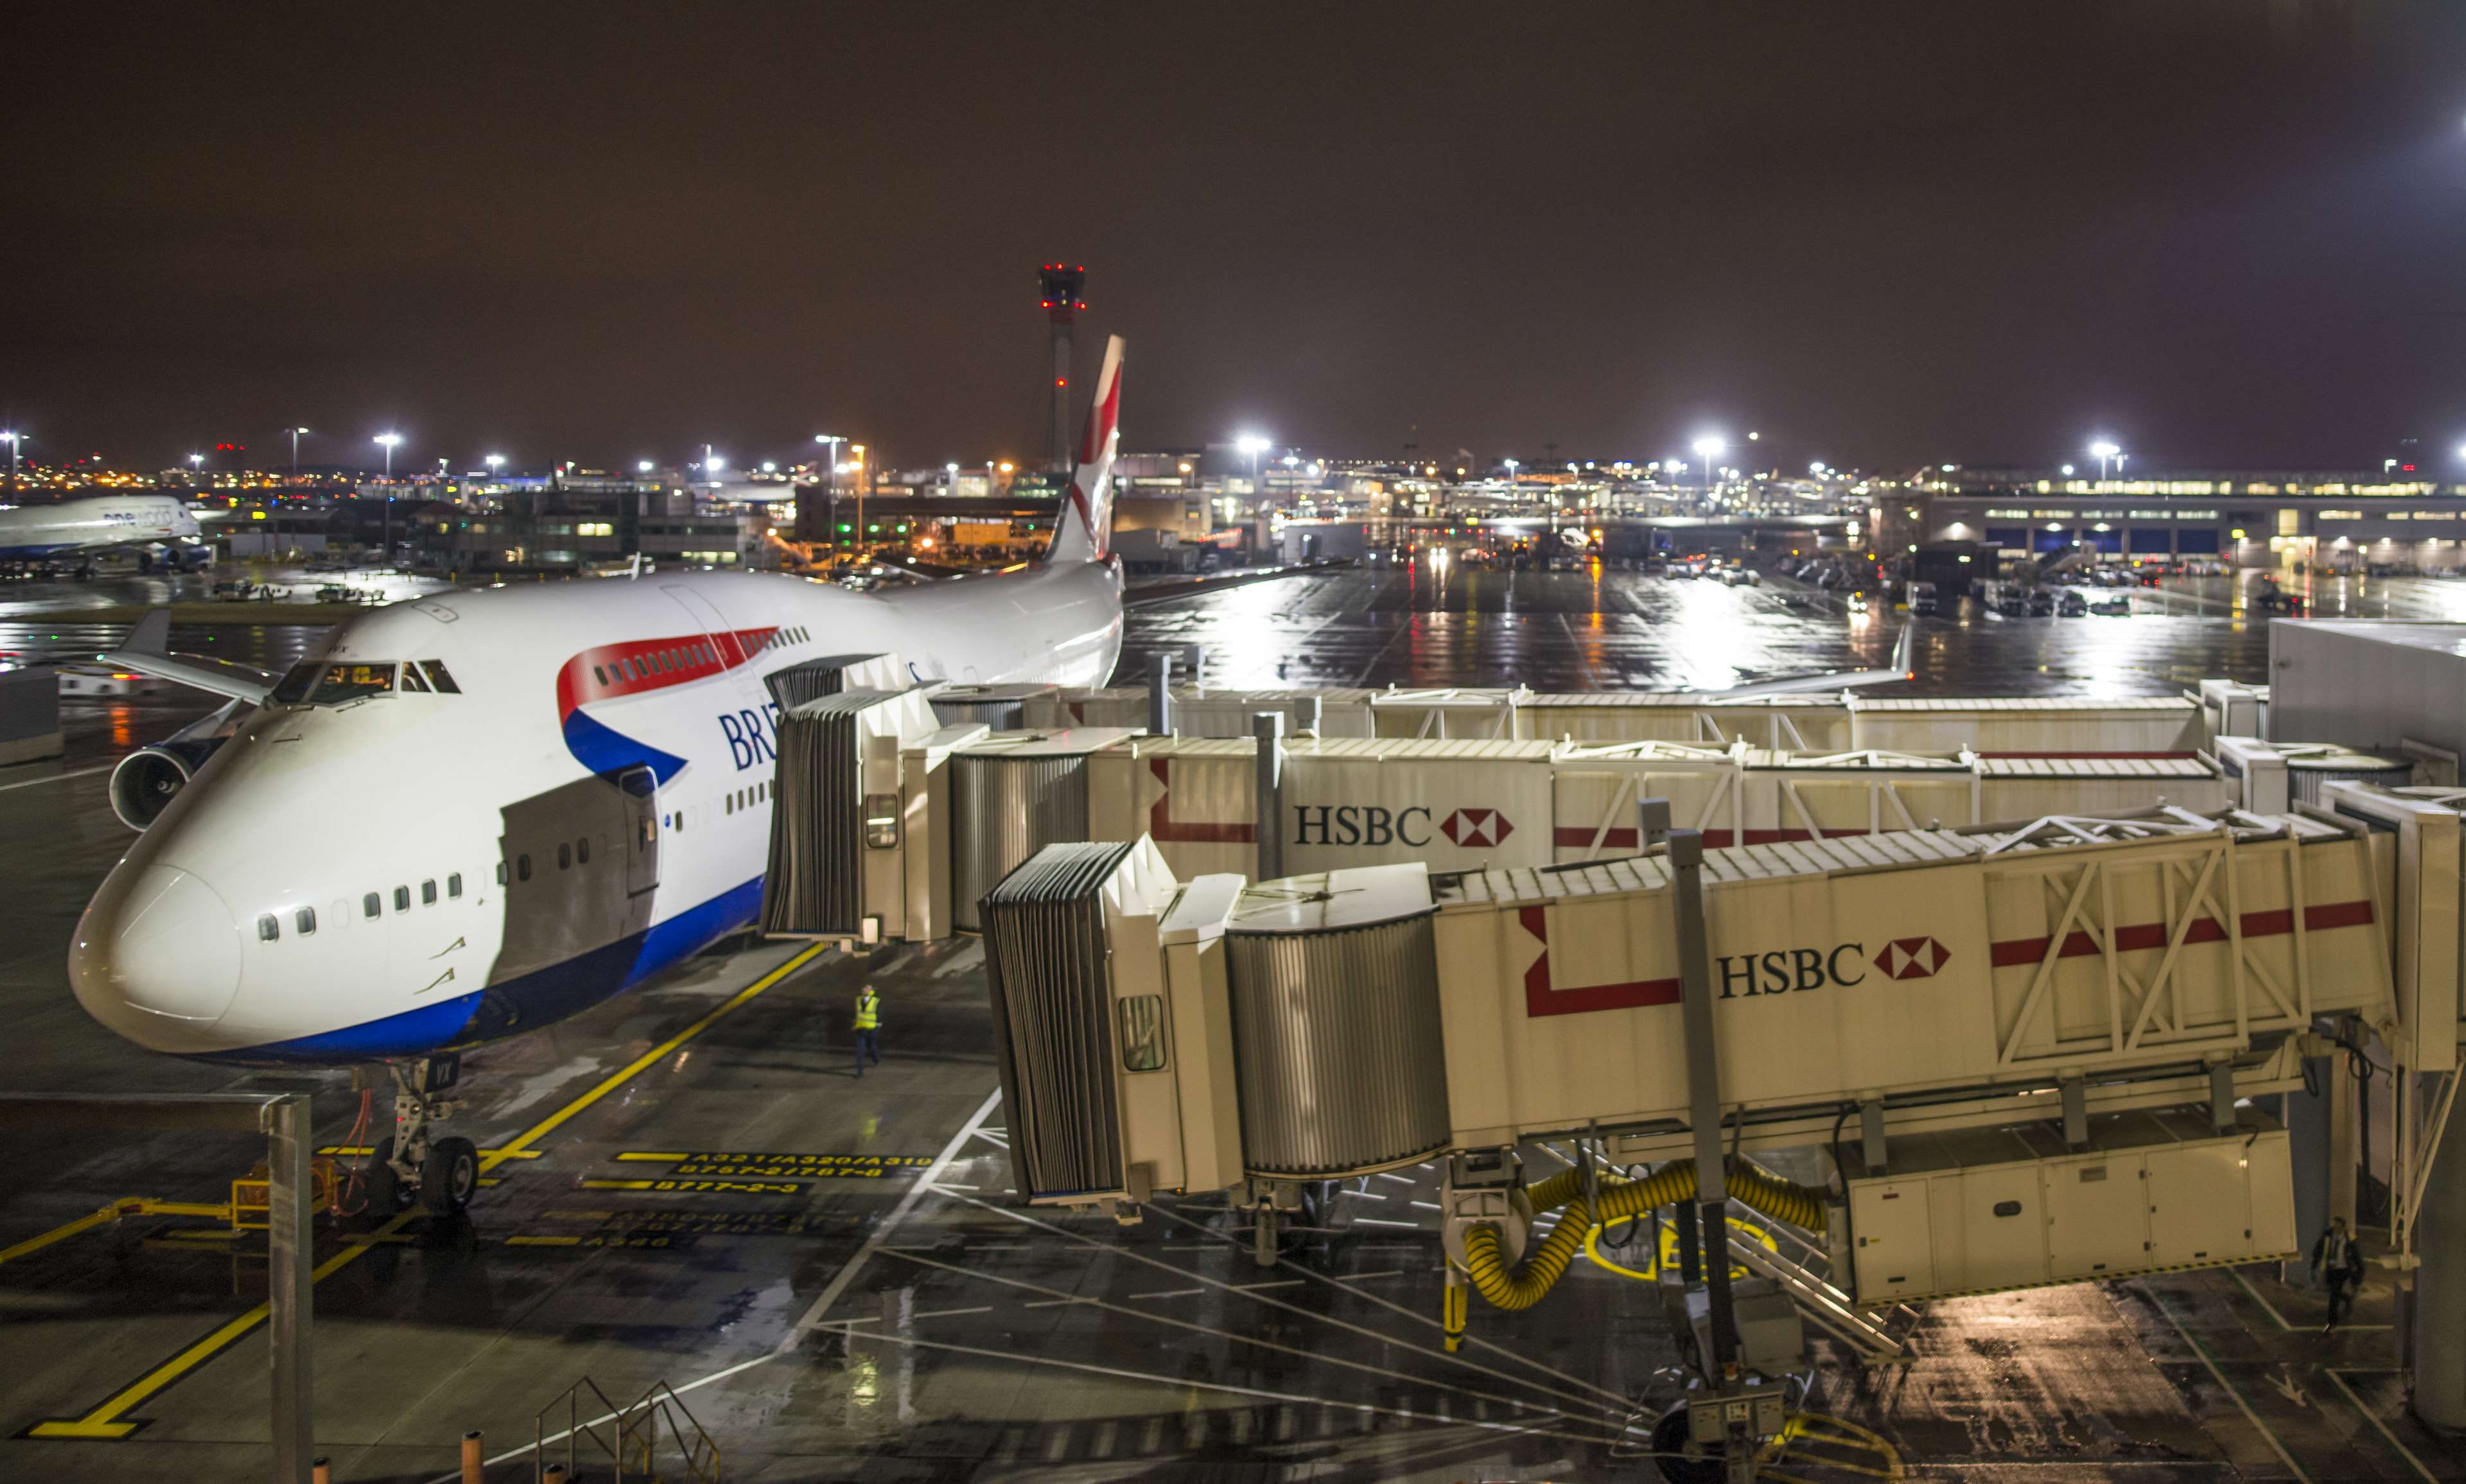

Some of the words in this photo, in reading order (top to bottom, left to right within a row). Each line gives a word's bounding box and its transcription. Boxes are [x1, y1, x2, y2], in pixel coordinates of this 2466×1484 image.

[718, 703, 779, 771] BRI
[1293, 805, 1432, 848] HSBC
[1715, 943, 1866, 999] HSBC
